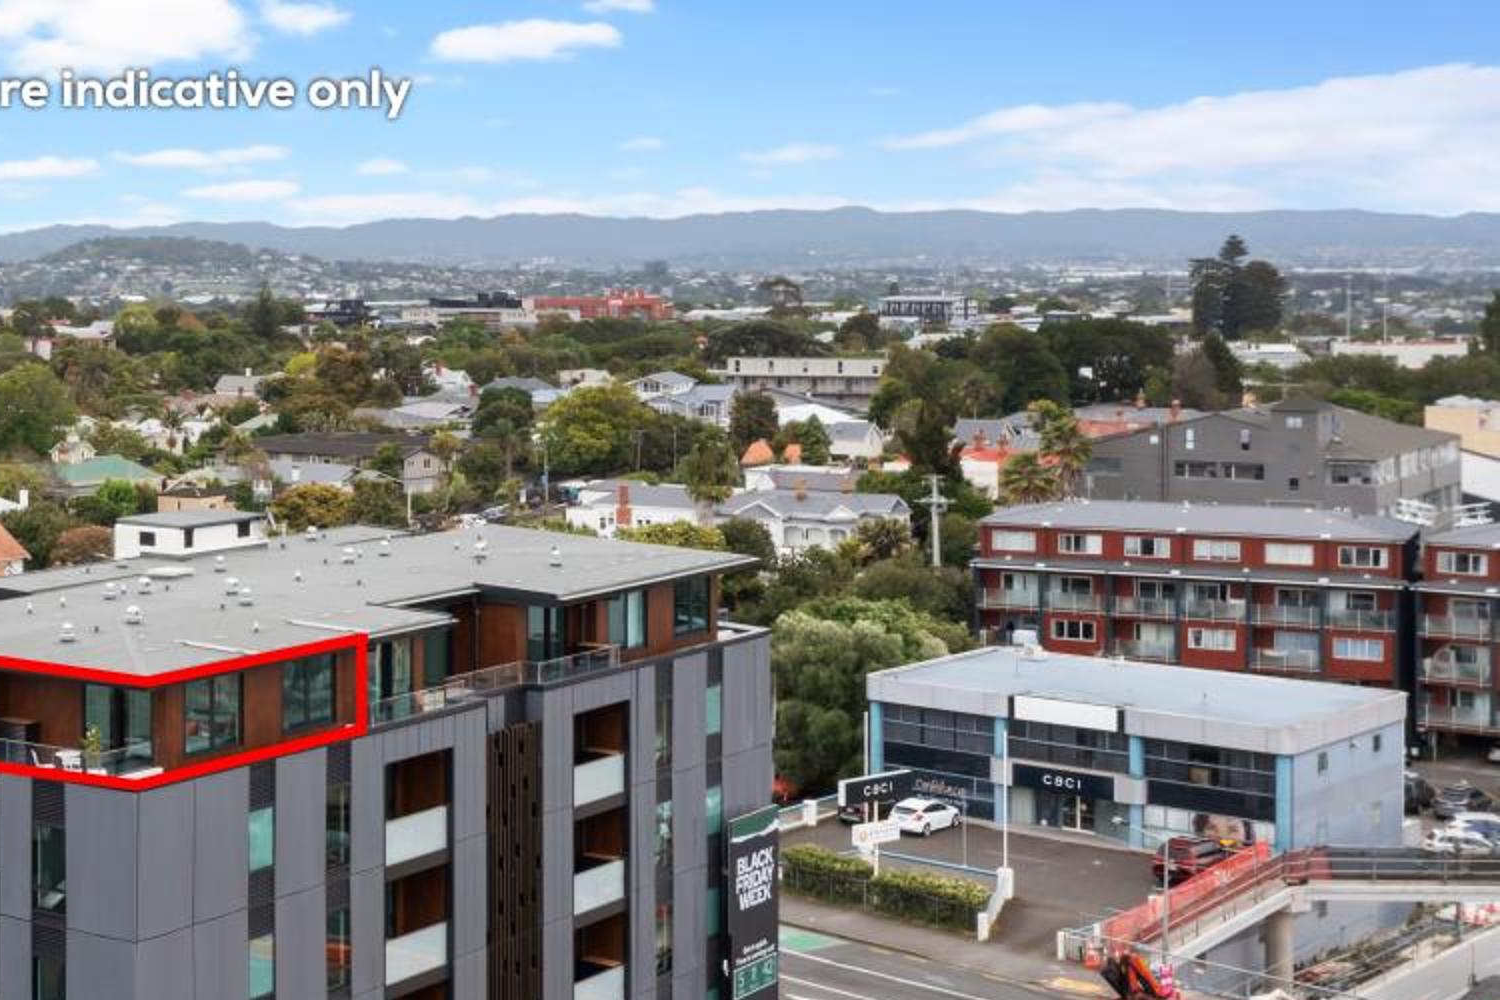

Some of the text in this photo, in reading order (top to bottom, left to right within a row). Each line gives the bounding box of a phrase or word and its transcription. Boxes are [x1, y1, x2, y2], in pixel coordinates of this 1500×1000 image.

[737, 846, 773, 876] BLACK
[735, 863, 775, 896] FRIDAY
[740, 882, 773, 911] WEEK
